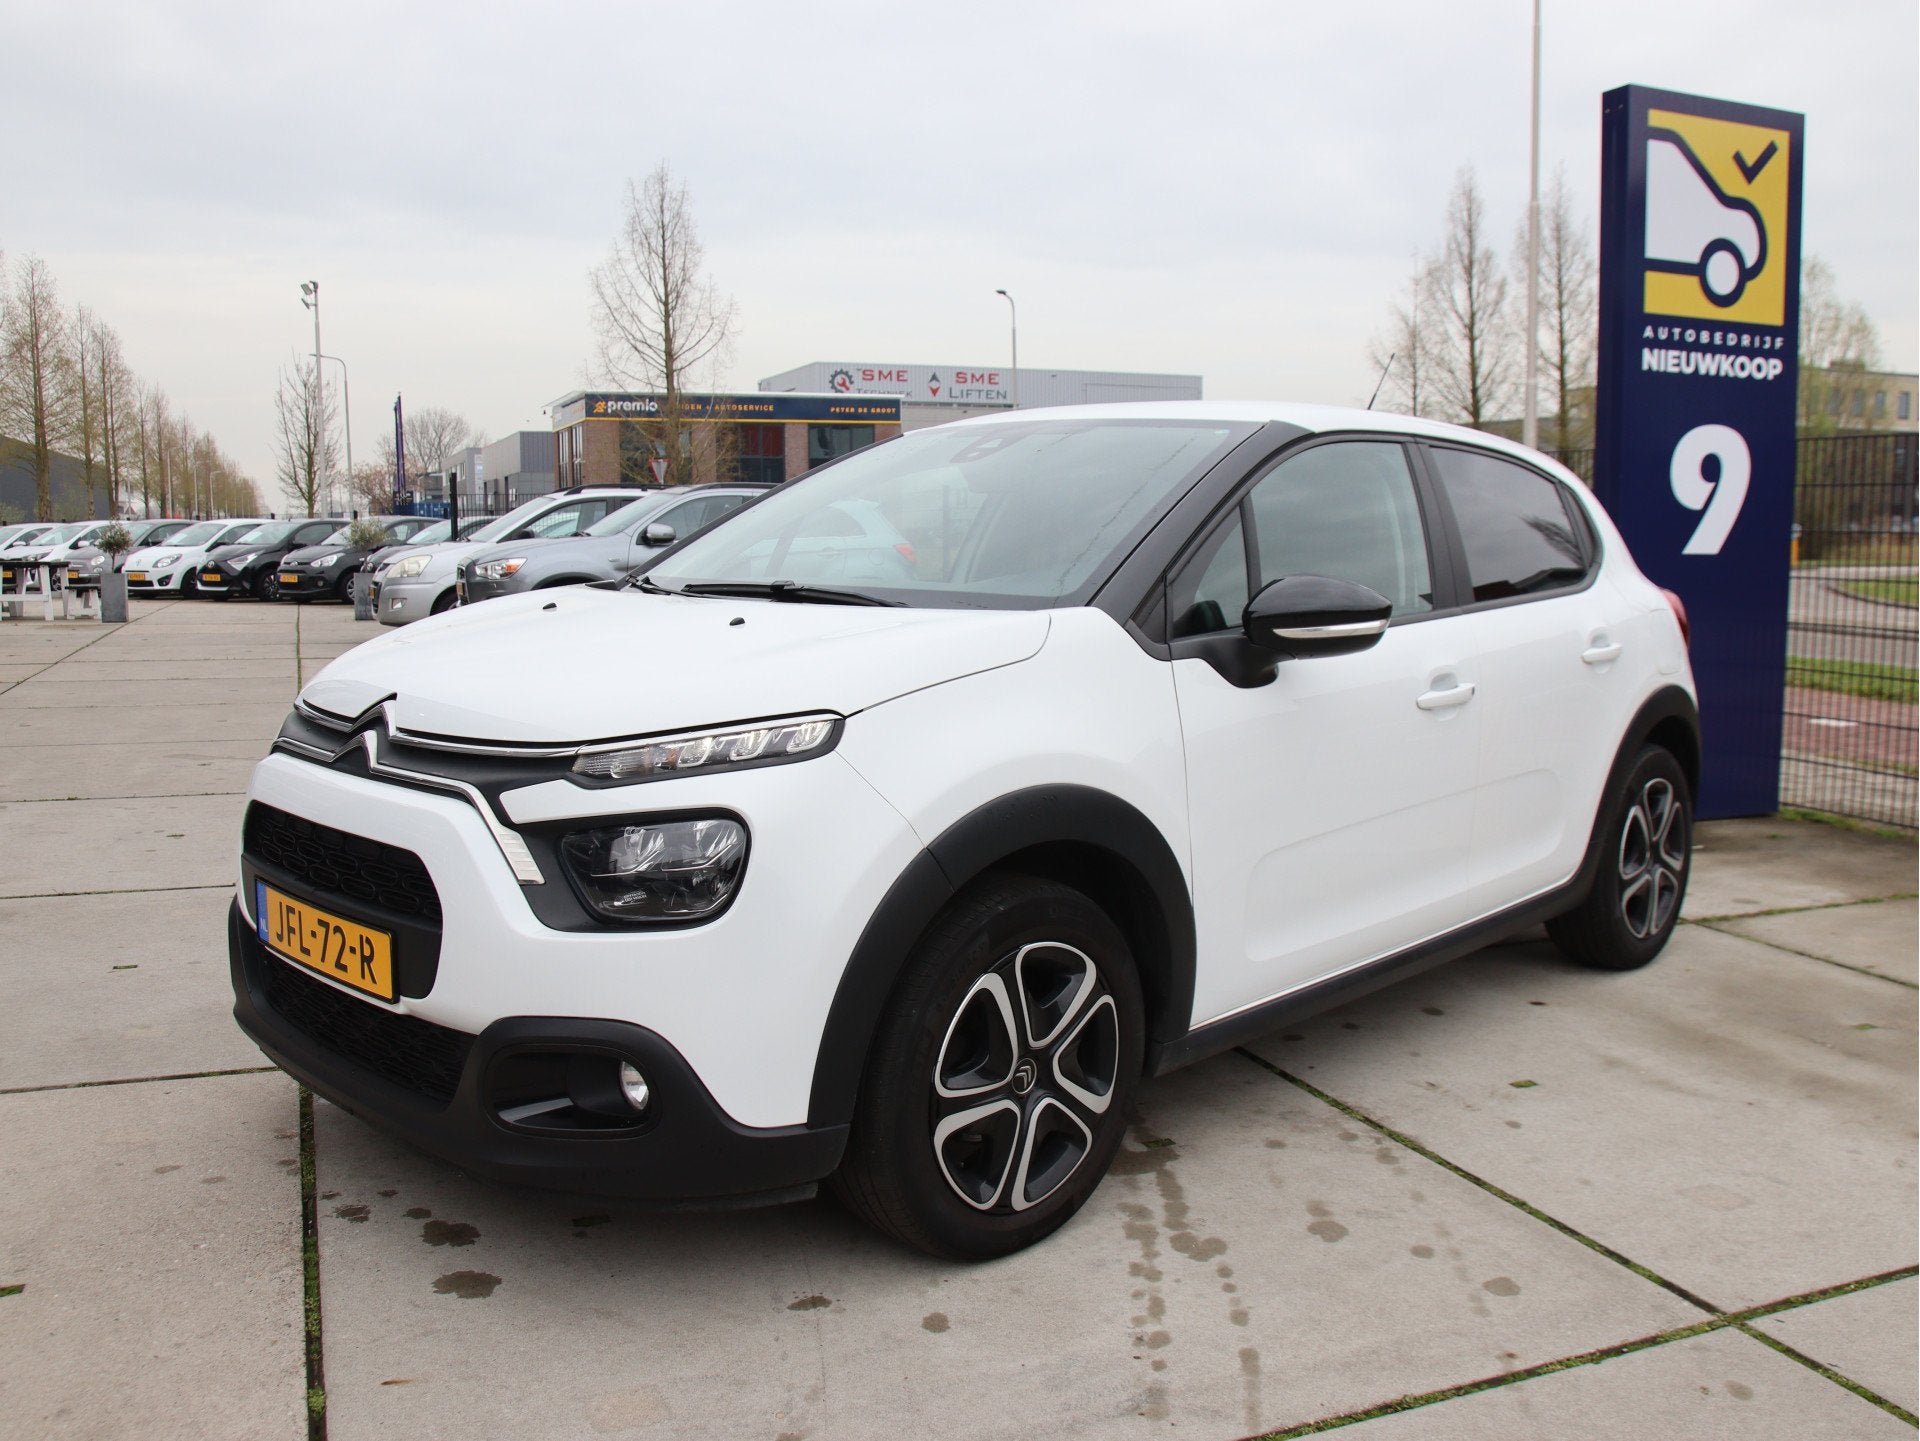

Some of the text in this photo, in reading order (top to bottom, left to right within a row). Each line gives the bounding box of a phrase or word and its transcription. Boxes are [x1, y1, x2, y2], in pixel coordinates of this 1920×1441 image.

[1643, 325, 1785, 350] AUTOBEDRIJF
[1641, 347, 1783, 381] NIEUWKOOP
[862, 369, 908, 382] SME
[955, 371, 1000, 385] SME
[949, 387, 1007, 400] LIFTEN
[607, 399, 659, 413] premio
[714, 404, 775, 412] AUTOSERVICE
[1669, 423, 1752, 556] 9
[259, 917, 268, 932] NL
[276, 901, 377, 985] JFL-72-R
